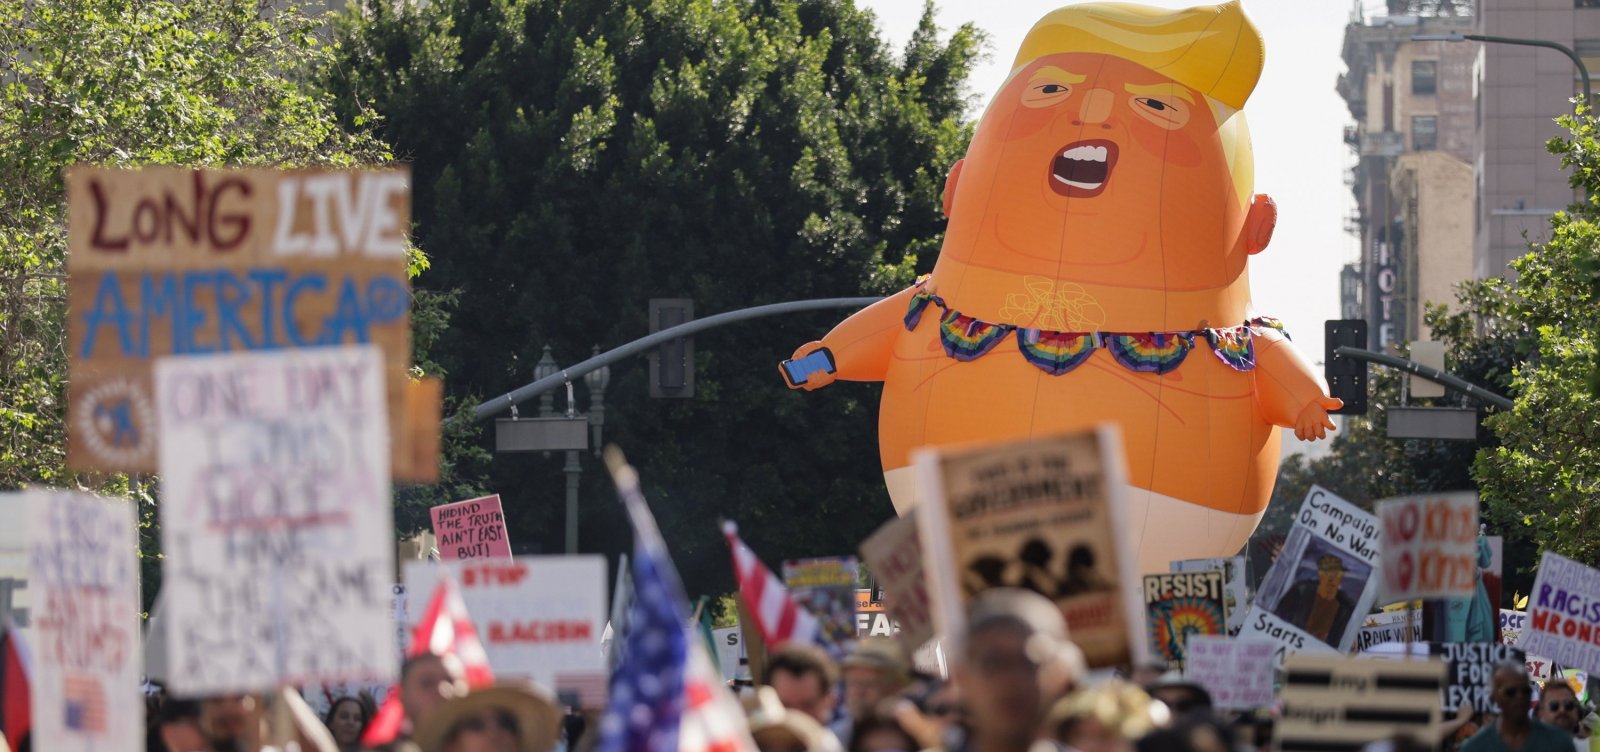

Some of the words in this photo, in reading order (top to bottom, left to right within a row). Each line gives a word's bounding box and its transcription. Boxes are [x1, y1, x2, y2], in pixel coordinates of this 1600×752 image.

[273, 173, 407, 258] LIVE
[1378, 242, 1397, 355] HOTE
[437, 518, 464, 529] THE
[468, 511, 503, 528] TRUTH
[441, 528, 475, 546] AIN'T
[478, 525, 502, 543] EASY
[1301, 509, 1318, 529] On
[1325, 522, 1344, 543] No
[1349, 533, 1380, 561] War
[1144, 572, 1221, 603] RESIST
[488, 620, 594, 643] RACISM
[1254, 613, 1305, 649] Starts
[1440, 642, 1516, 663] JUSTICE
